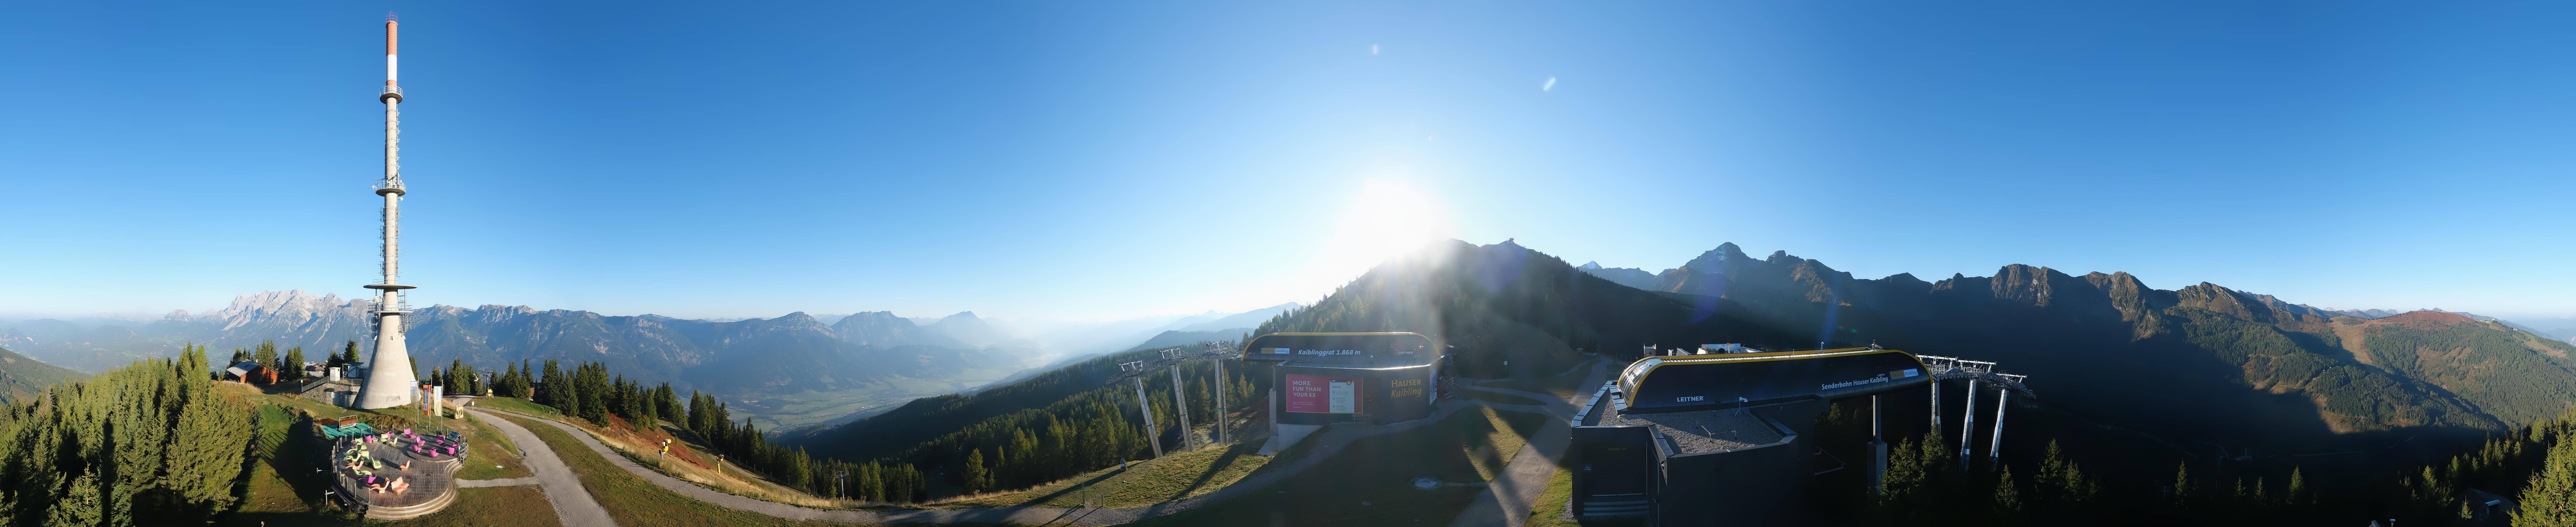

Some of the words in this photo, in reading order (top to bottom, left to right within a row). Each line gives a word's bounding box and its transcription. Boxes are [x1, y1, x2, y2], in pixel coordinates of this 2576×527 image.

[1392, 379, 1421, 387] HAUSER
[1822, 381, 1852, 390] Senderbahn
[1391, 388, 1422, 397] Kaibling
